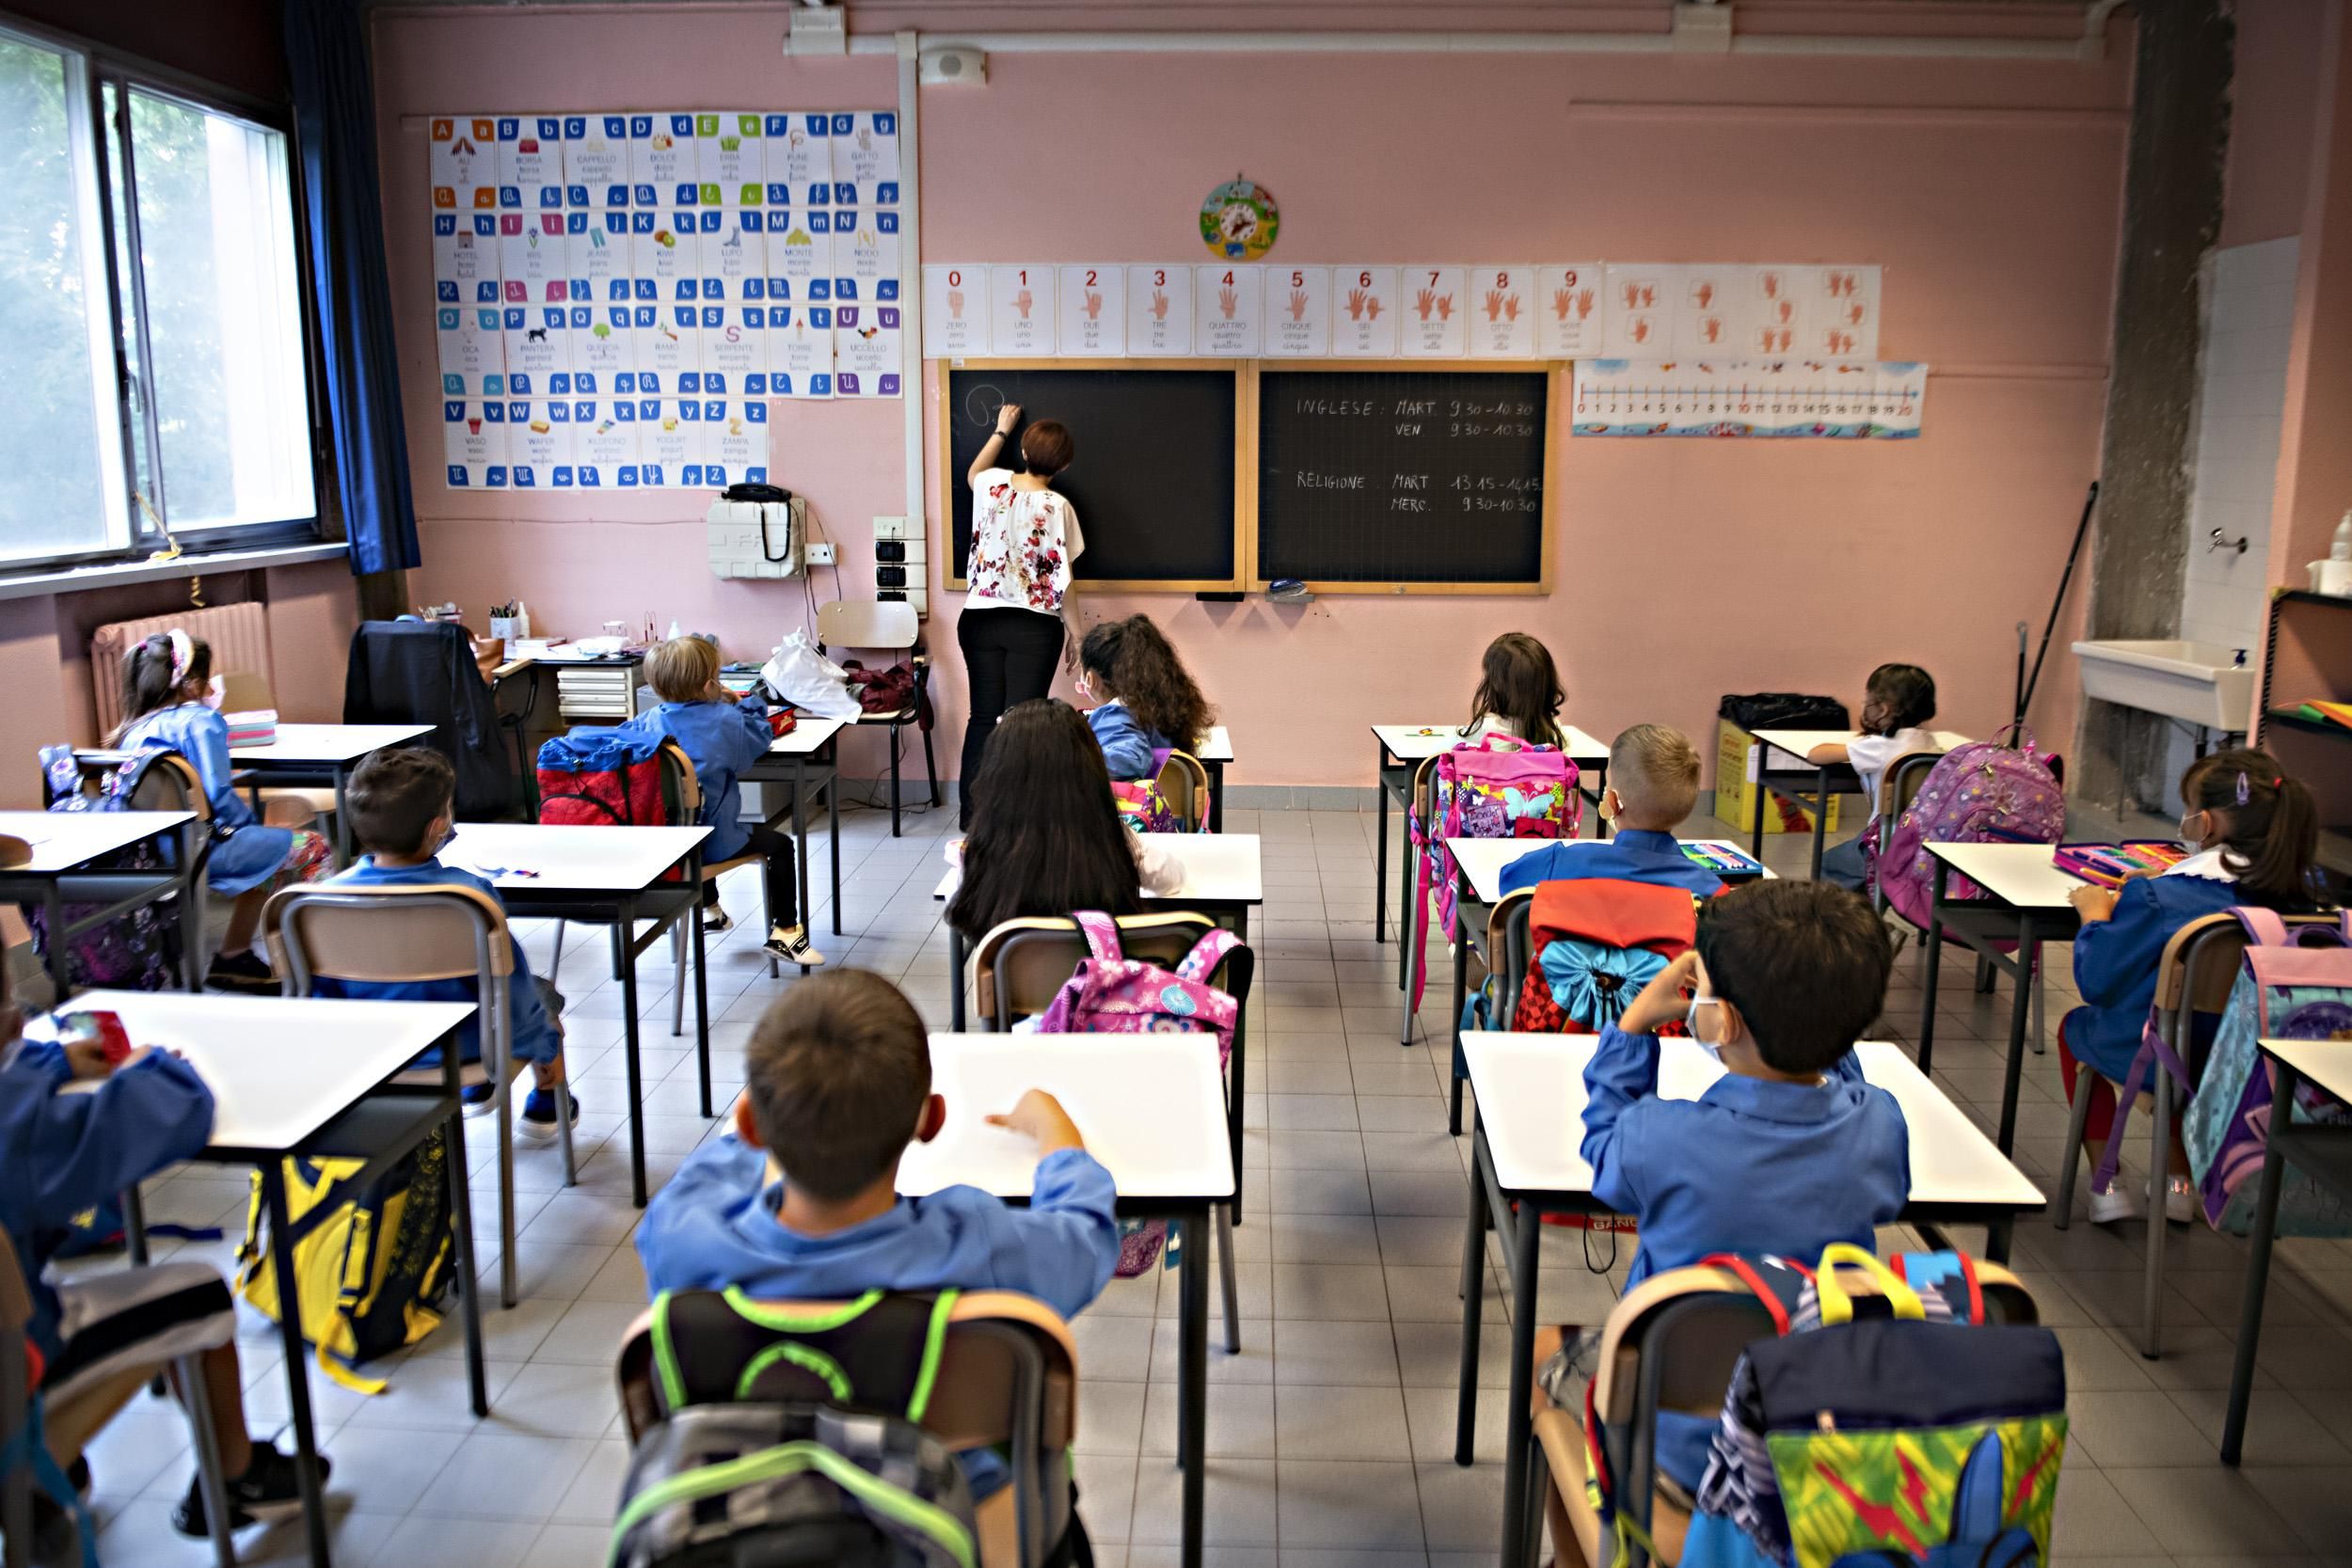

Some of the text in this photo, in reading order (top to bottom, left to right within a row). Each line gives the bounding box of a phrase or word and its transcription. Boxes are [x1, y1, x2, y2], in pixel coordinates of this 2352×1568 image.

[437, 123, 487, 136] A a
[503, 122, 553, 135] B b
[569, 121, 619, 135] C c
[636, 119, 687, 134] D d
[703, 119, 711, 133] E
[771, 119, 780, 132] F
[836, 118, 889, 133] G g
[440, 218, 489, 231] H h
[574, 215, 580, 230] J
[639, 215, 689, 229] K k
[707, 214, 715, 229] L
[772, 214, 825, 228] M m
[840, 214, 892, 229] N n
[785, 248, 813, 257] MONTE
[948, 270, 961, 287] 0
[1019, 270, 1026, 286] 1
[1086, 270, 1097, 286] 2
[1154, 270, 1166, 286] 3
[1223, 271, 1234, 286] 4
[1292, 271, 1303, 287] 5
[1359, 271, 1372, 288] 6
[1428, 271, 1439, 288] 7
[1496, 272, 1509, 288] 8
[1565, 271, 1577, 287] 9
[443, 312, 494, 325] O o
[510, 311, 560, 326] P p
[575, 310, 625, 325] Q q
[641, 309, 689, 323] R r
[707, 309, 757, 325] S s
[774, 309, 784, 323] T
[842, 310, 893, 324] U u
[1209, 322, 1247, 330] QUATTRO
[450, 405, 499, 418] V v
[512, 405, 565, 418] W w
[580, 405, 628, 418] X x
[645, 403, 693, 419] Y y
[710, 404, 719, 417] Z
[1578, 404, 1585, 414] 0
[1596, 404, 1600, 413] 1
[1610, 404, 1616, 413] 2
[1627, 404, 1633, 413] 3
[1659, 404, 1665, 414] 5
[1675, 404, 1681, 414] 6
[1692, 404, 1698, 413] 7
[1708, 404, 1715, 414] 8
[1724, 404, 1731, 414] 9
